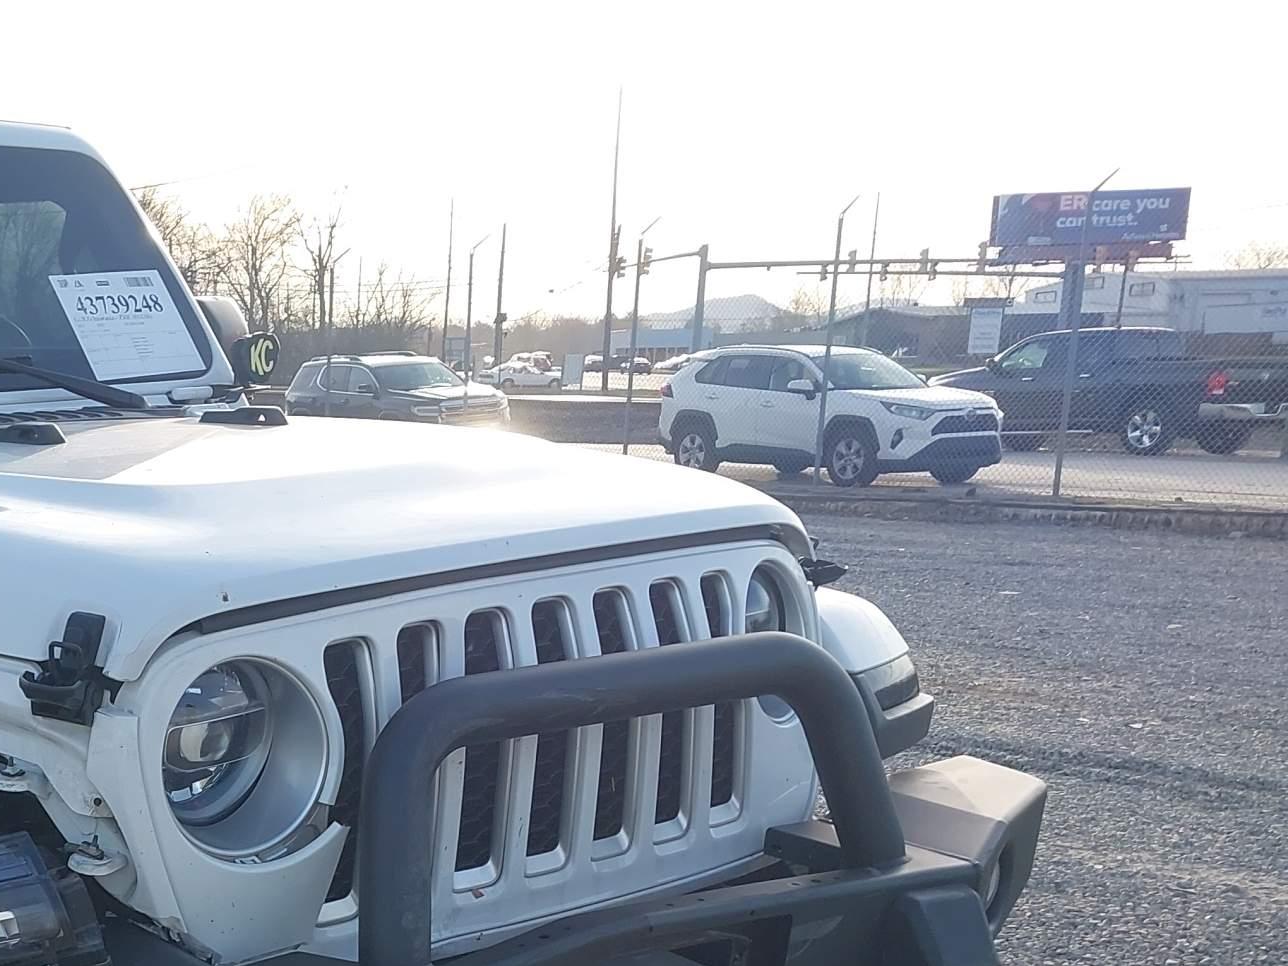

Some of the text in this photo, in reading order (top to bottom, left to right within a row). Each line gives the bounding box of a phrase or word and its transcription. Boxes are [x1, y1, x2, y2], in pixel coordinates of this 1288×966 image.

[1059, 194, 1171, 213] ER care you
[1092, 213, 1138, 226] trust.
[76, 294, 164, 315] 43739248
[250, 338, 274, 376] KC
